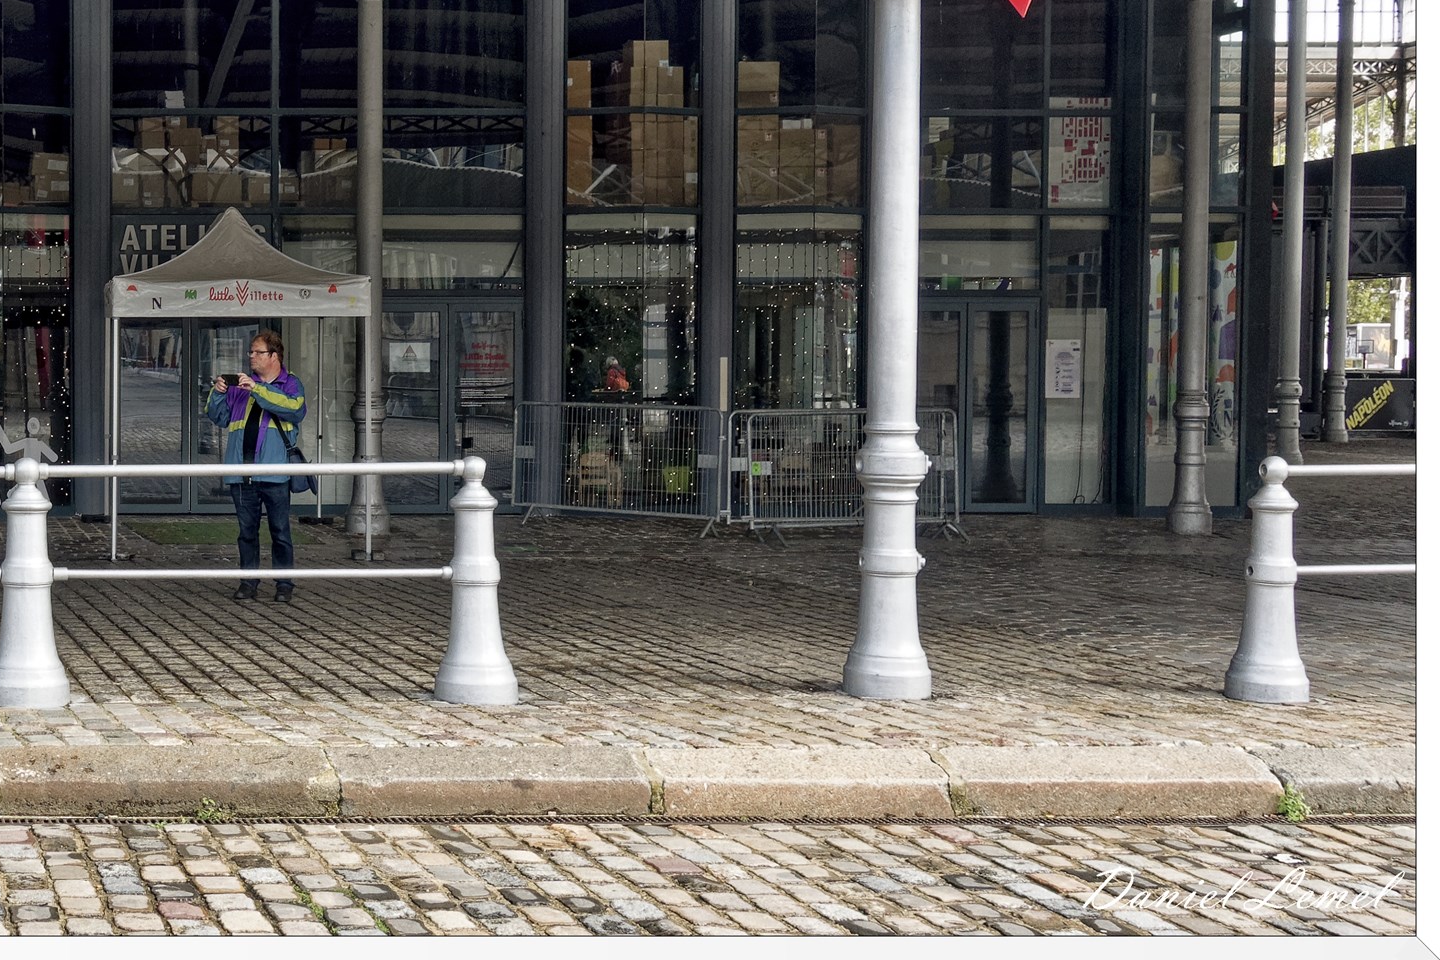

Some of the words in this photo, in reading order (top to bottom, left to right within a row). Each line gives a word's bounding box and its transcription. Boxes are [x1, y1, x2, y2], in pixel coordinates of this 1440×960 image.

[120, 224, 266, 251] ATELIS
[152, 297, 162, 310] N
[209, 287, 235, 301] little
[236, 280, 284, 307] Villette
[1345, 380, 1394, 431] NAPOLÉON
